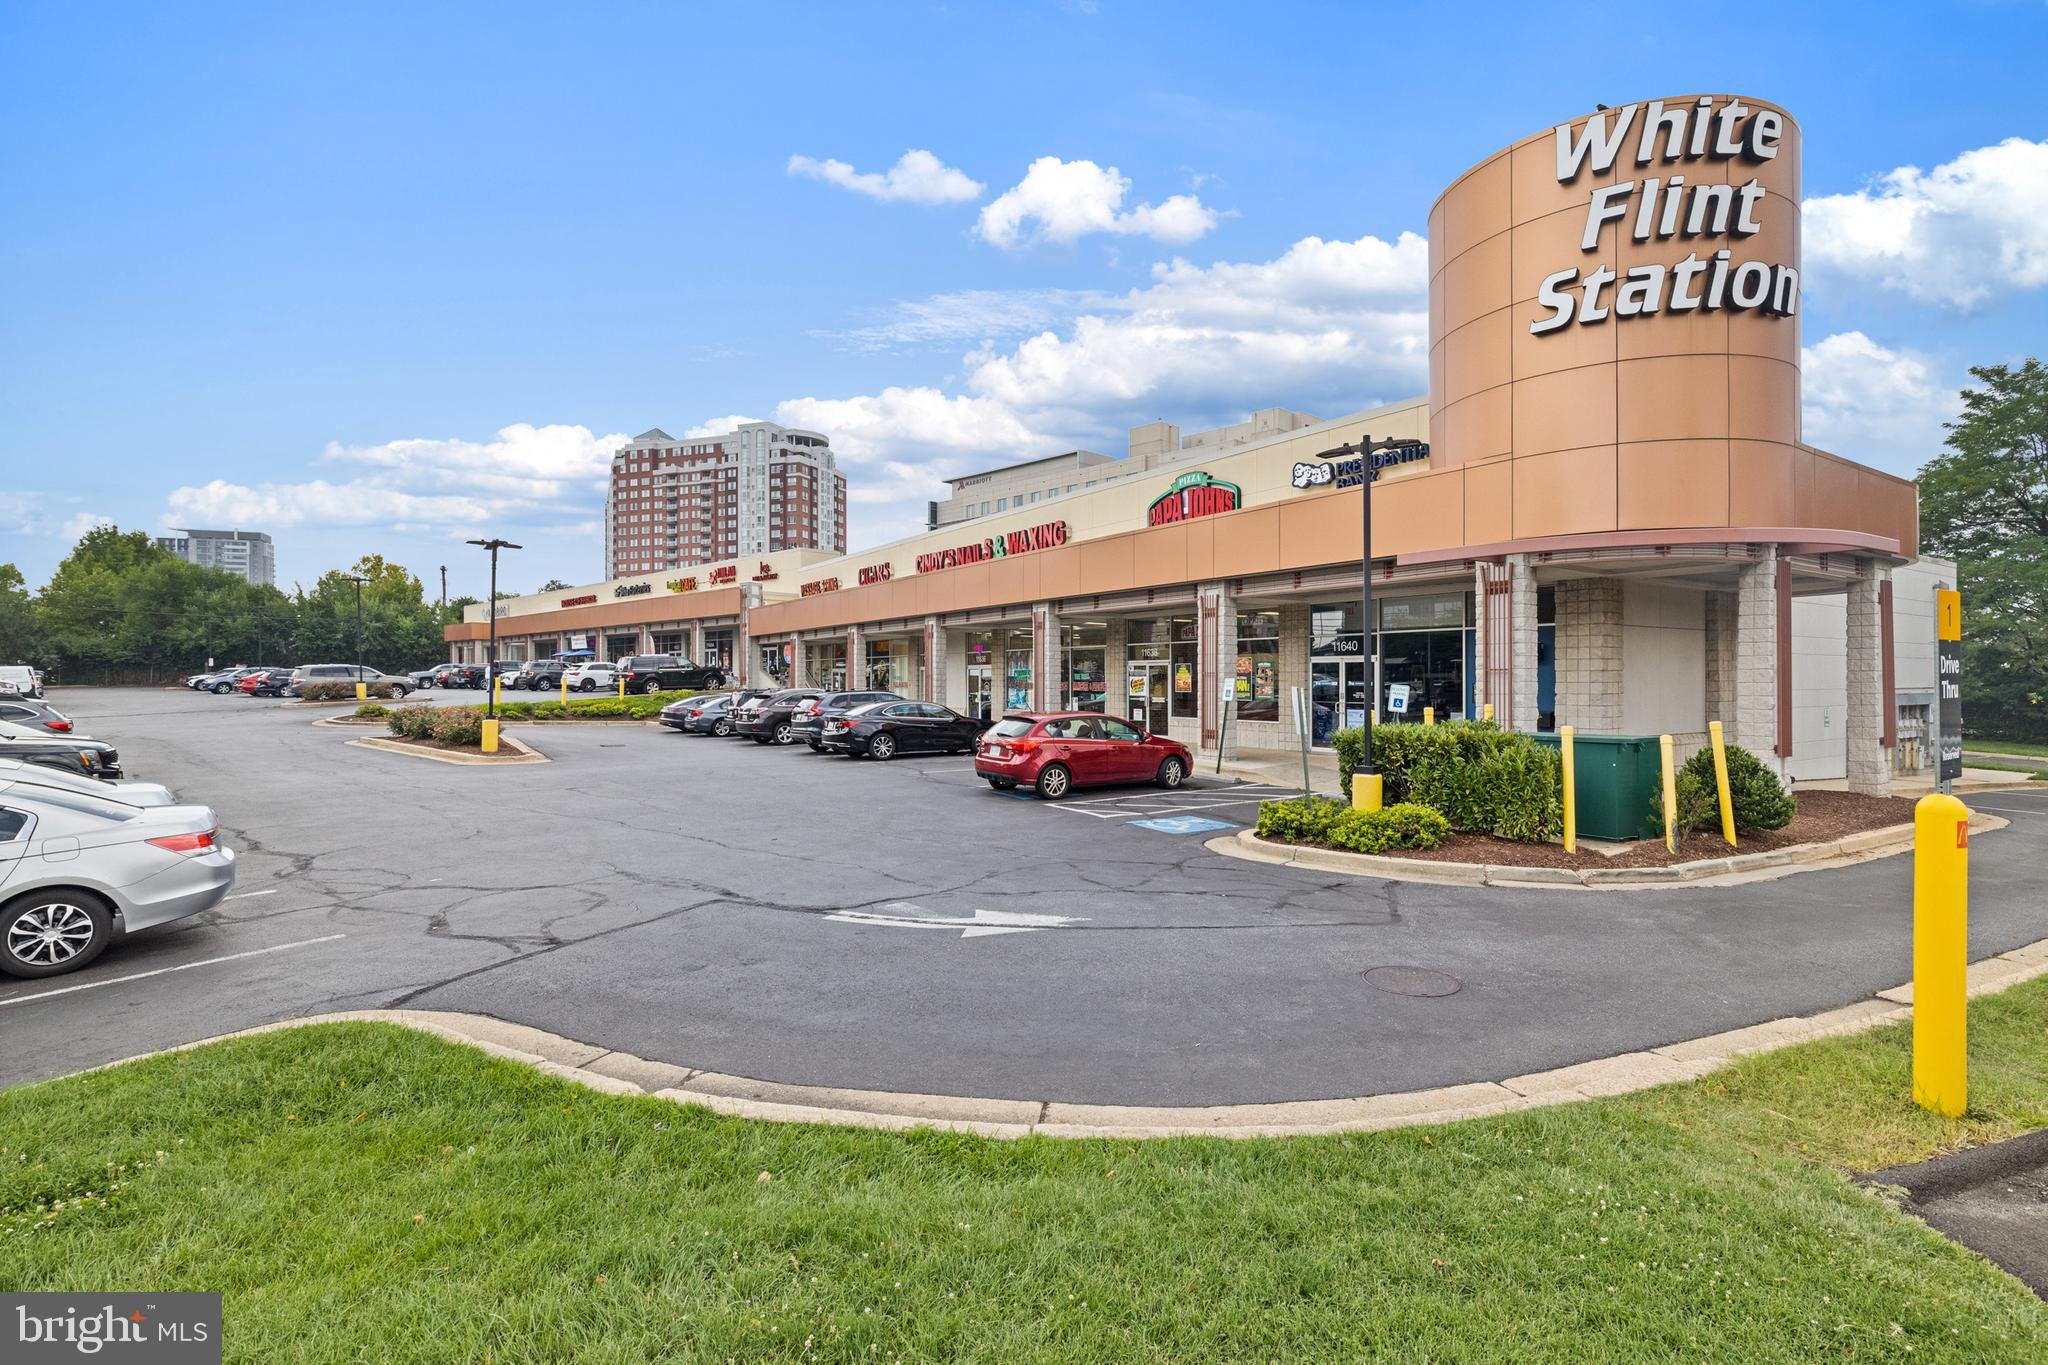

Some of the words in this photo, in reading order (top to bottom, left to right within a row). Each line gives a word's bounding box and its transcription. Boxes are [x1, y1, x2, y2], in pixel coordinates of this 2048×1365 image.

[1556, 96, 1783, 184] White
[1581, 175, 1766, 251] Flint
[1529, 249, 1799, 337] Station
[1336, 444, 1429, 477] PREDENTIA
[1179, 473, 1201, 486] PIZZA
[1149, 491, 1183, 527] PAPA
[915, 549, 956, 574] CINDY'S
[956, 538, 993, 566] NAILS
[994, 535, 1006, 557] &
[1007, 520, 1066, 555] WAXING
[858, 562, 890, 586] CIGARS
[1946, 603, 1952, 627] 1
[1332, 640, 1358, 652] 11640
[1940, 654, 1960, 674] Drive
[1941, 680, 1959, 699] Thru
